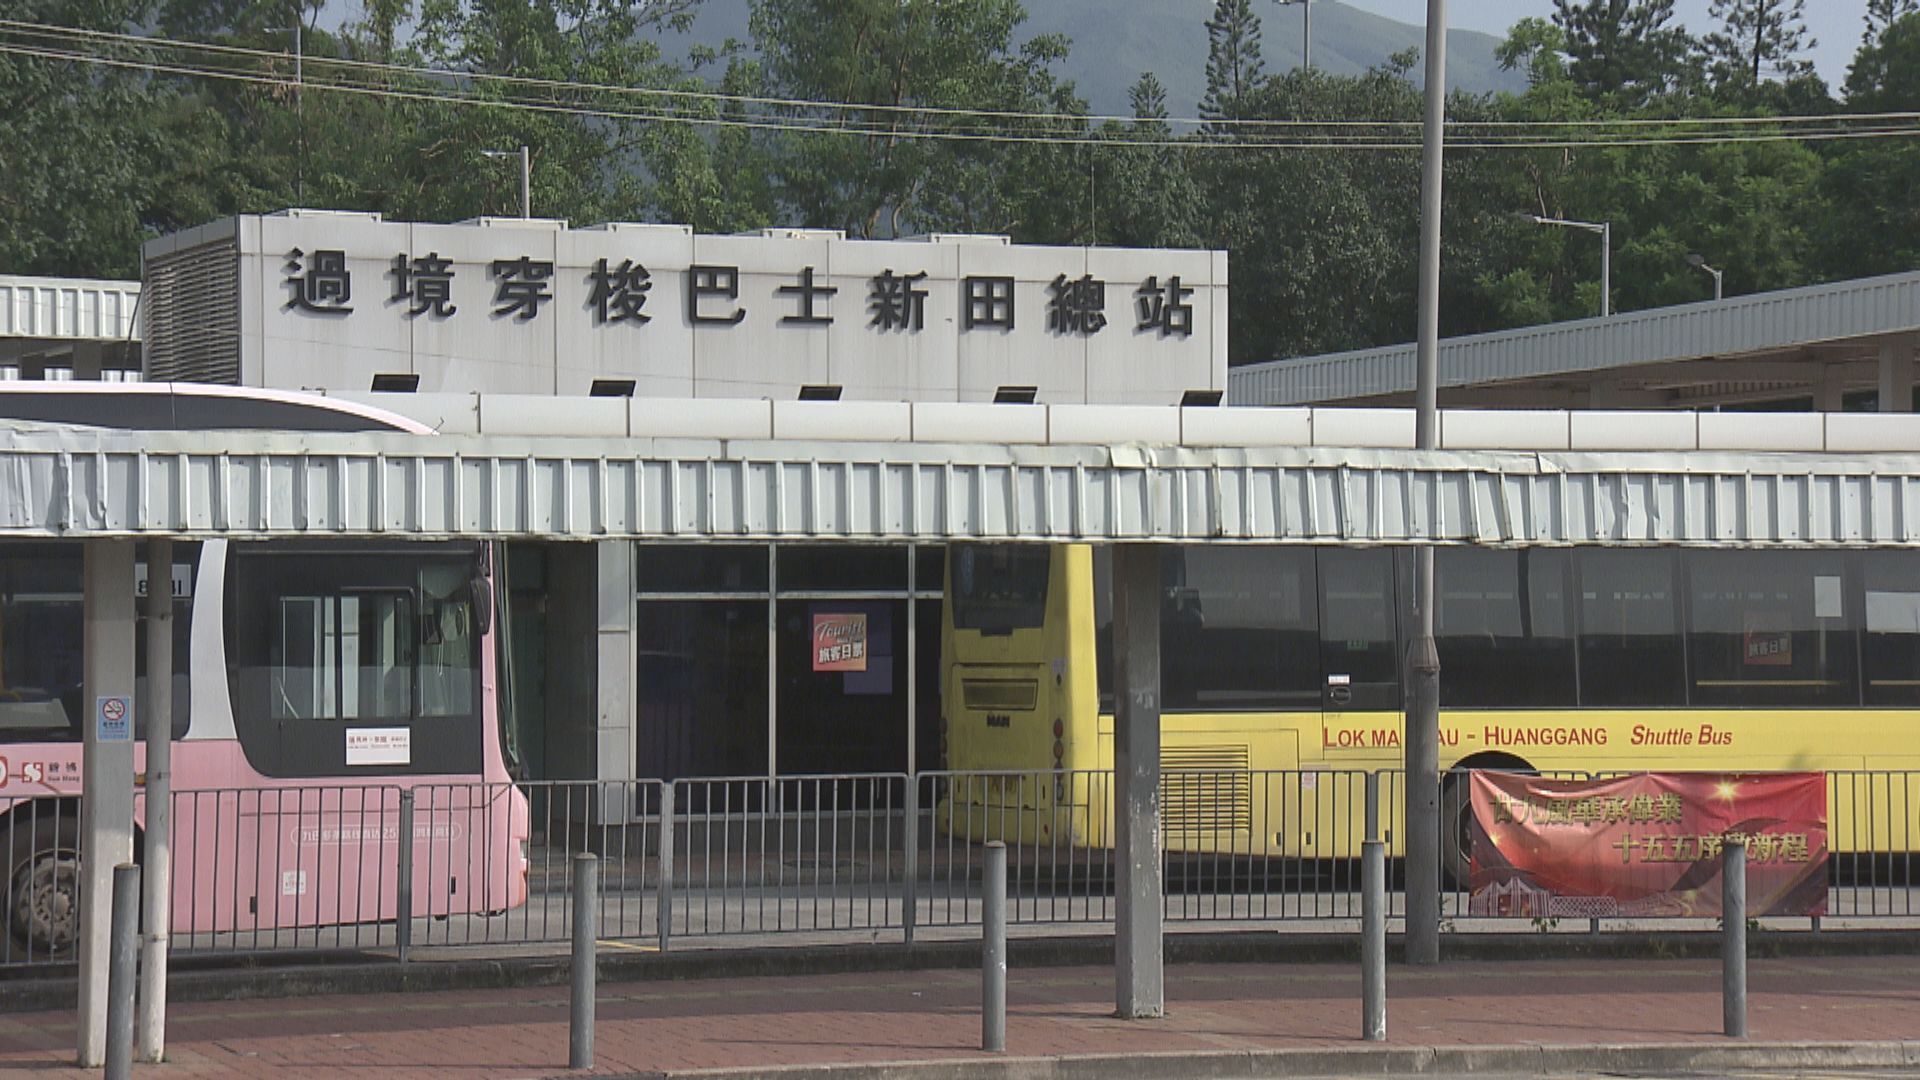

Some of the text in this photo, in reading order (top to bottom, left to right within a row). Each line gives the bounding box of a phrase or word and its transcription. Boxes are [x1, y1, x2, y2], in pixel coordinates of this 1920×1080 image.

[285, 246, 1195, 336] 過境穿梭巴士新田總站
[1323, 727, 1365, 747] LOK
[1371, 729, 1400, 747] MA
[1484, 726, 1607, 746] HUANGGANG
[1630, 724, 1733, 746] Shuttle Bus
